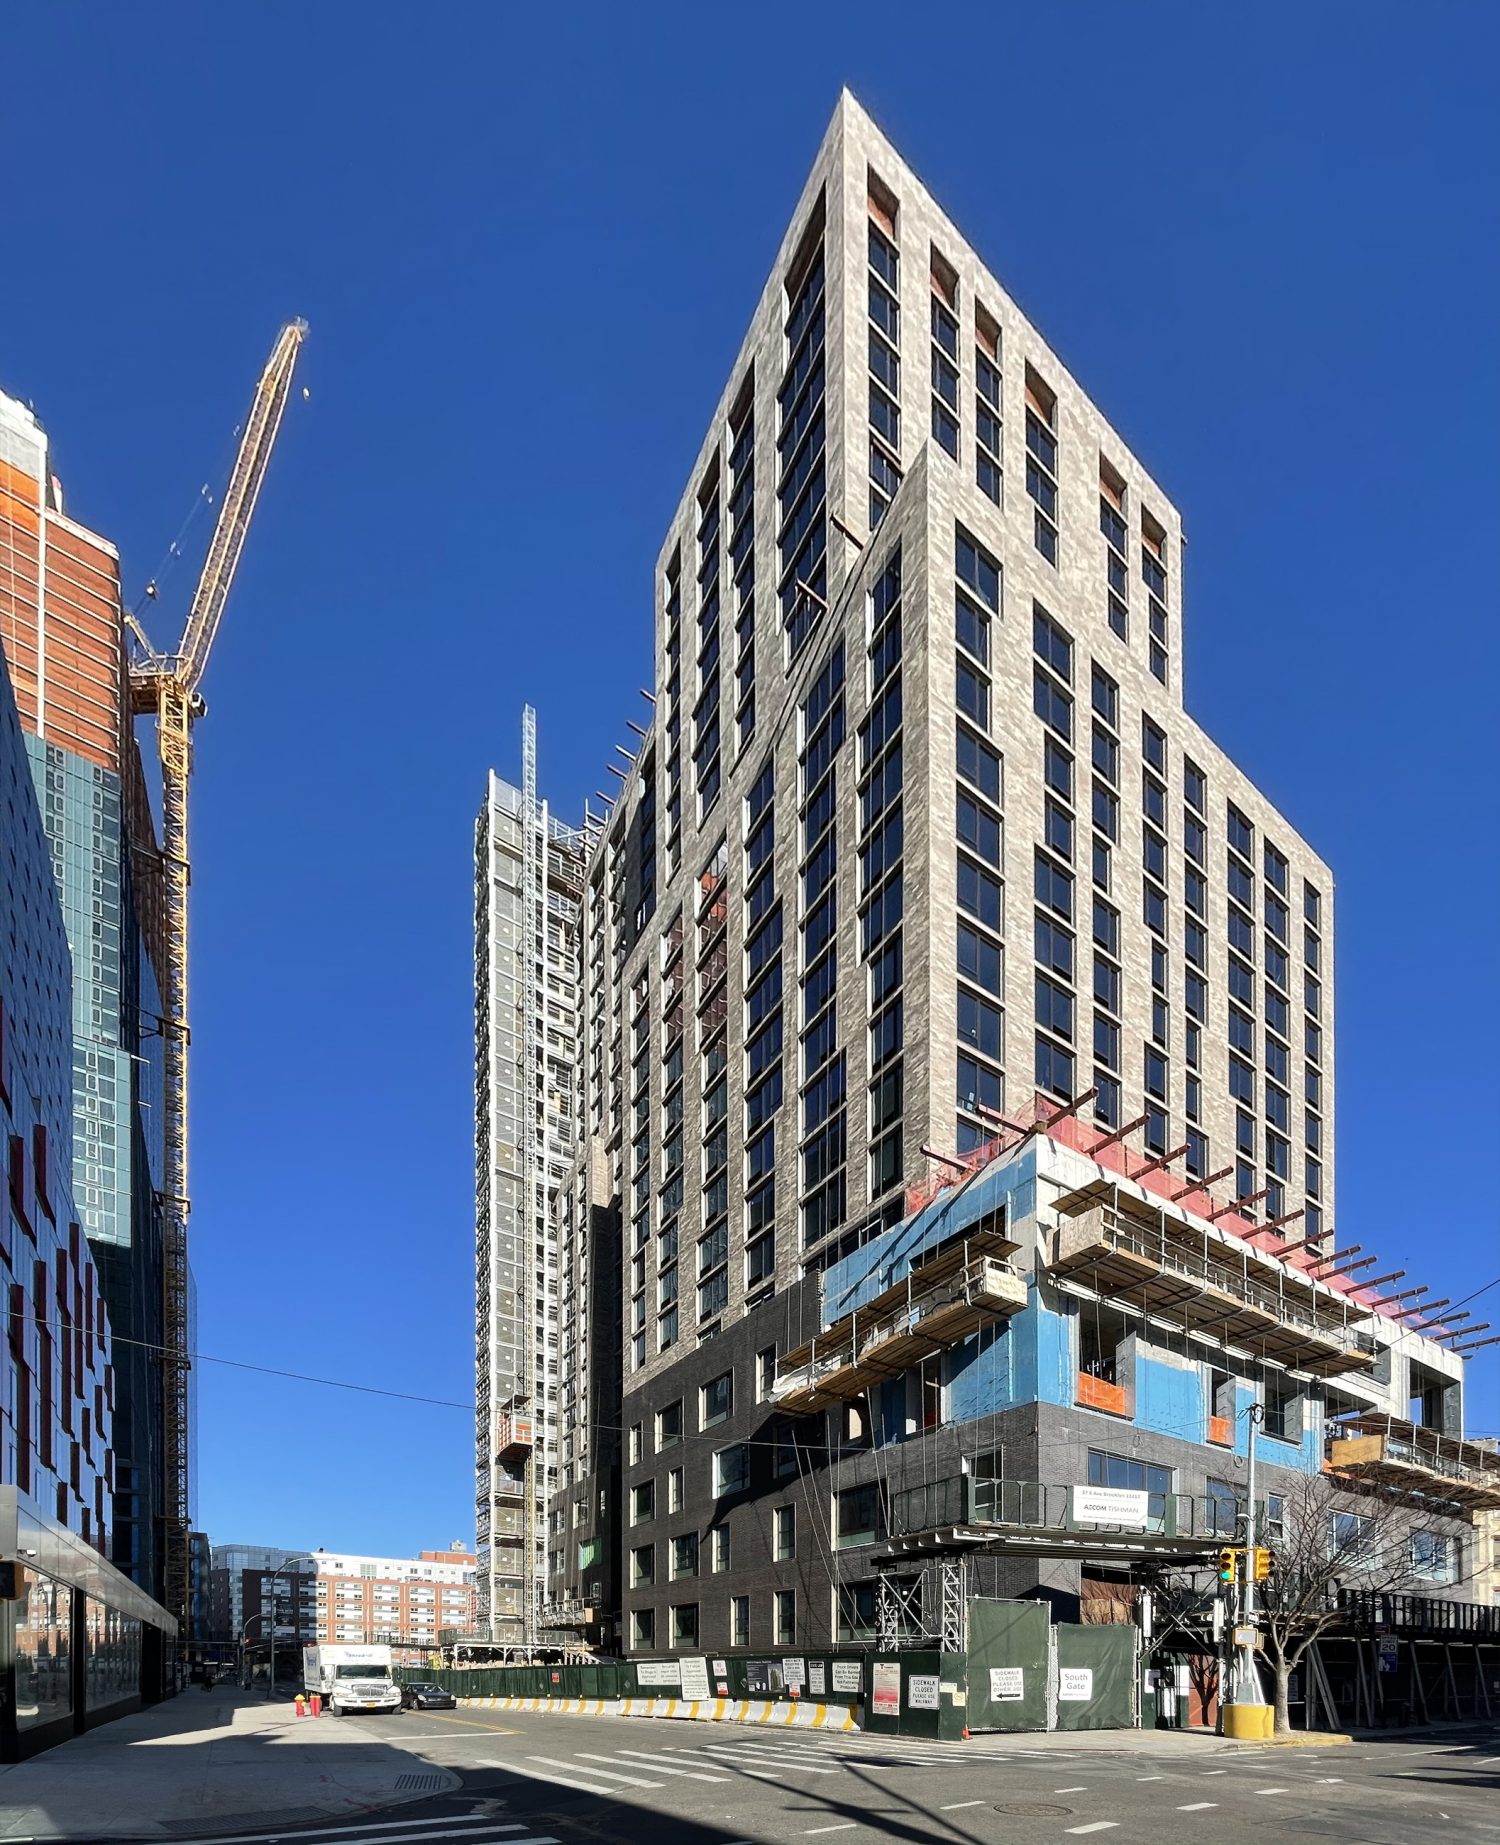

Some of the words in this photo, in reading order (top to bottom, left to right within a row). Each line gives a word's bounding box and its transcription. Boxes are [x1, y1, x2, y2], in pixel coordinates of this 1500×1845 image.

[1083, 1504, 1107, 1512] AECOM
[1108, 1505, 1139, 1513] TISHMAN
[1064, 1673, 1088, 1681] South
[1066, 1682, 1086, 1690] Gate
